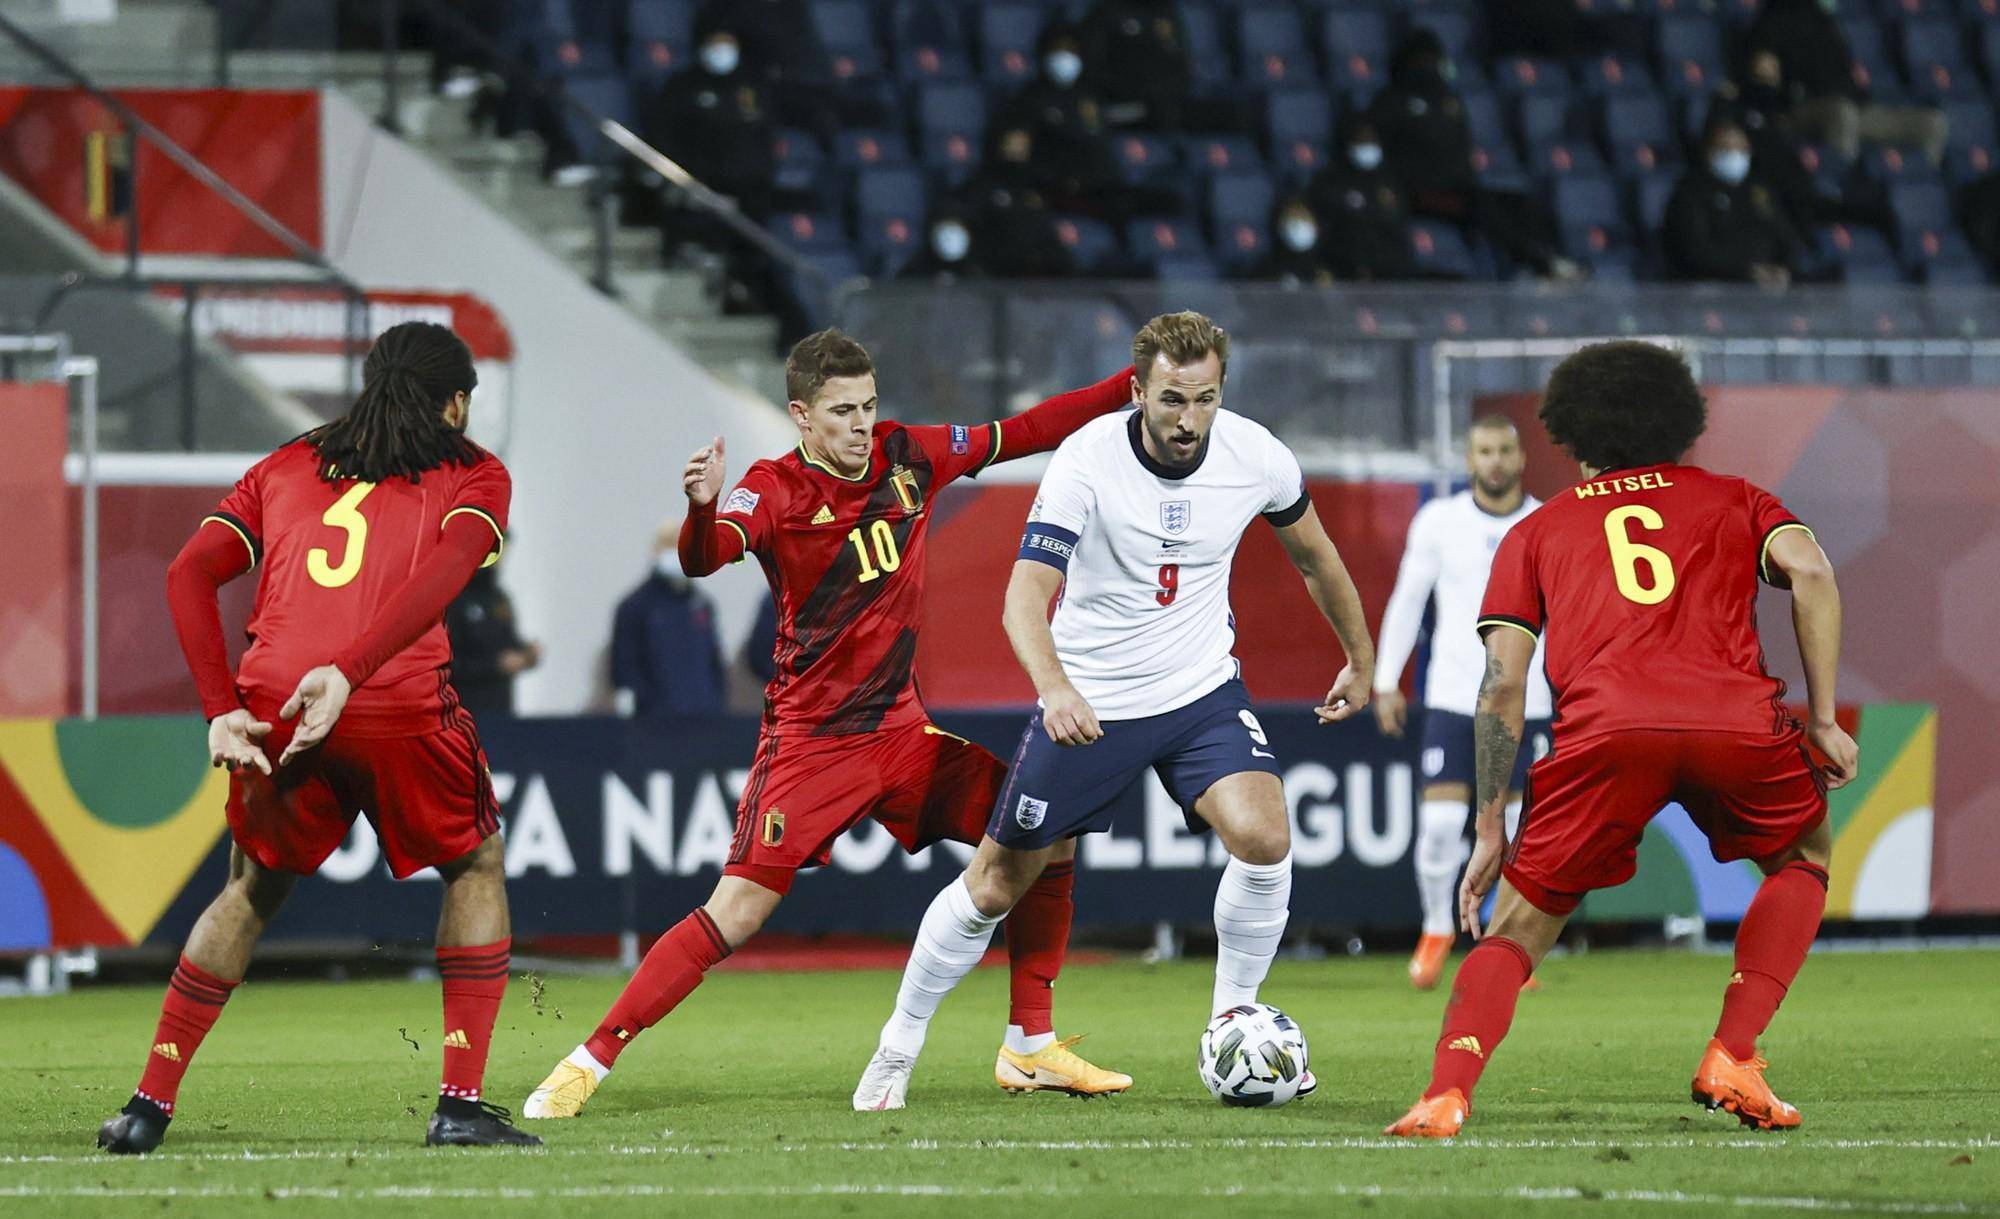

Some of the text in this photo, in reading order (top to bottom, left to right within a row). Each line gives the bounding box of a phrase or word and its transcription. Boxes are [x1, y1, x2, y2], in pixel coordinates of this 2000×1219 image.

[1574, 472, 1674, 500] WITSEL
[306, 481, 376, 588] 3
[848, 519, 900, 583] 10
[1041, 538, 1074, 557] RESPEC
[1604, 504, 1676, 605] 6
[1155, 564, 1179, 607] 9
[1238, 708, 1268, 746] 9
